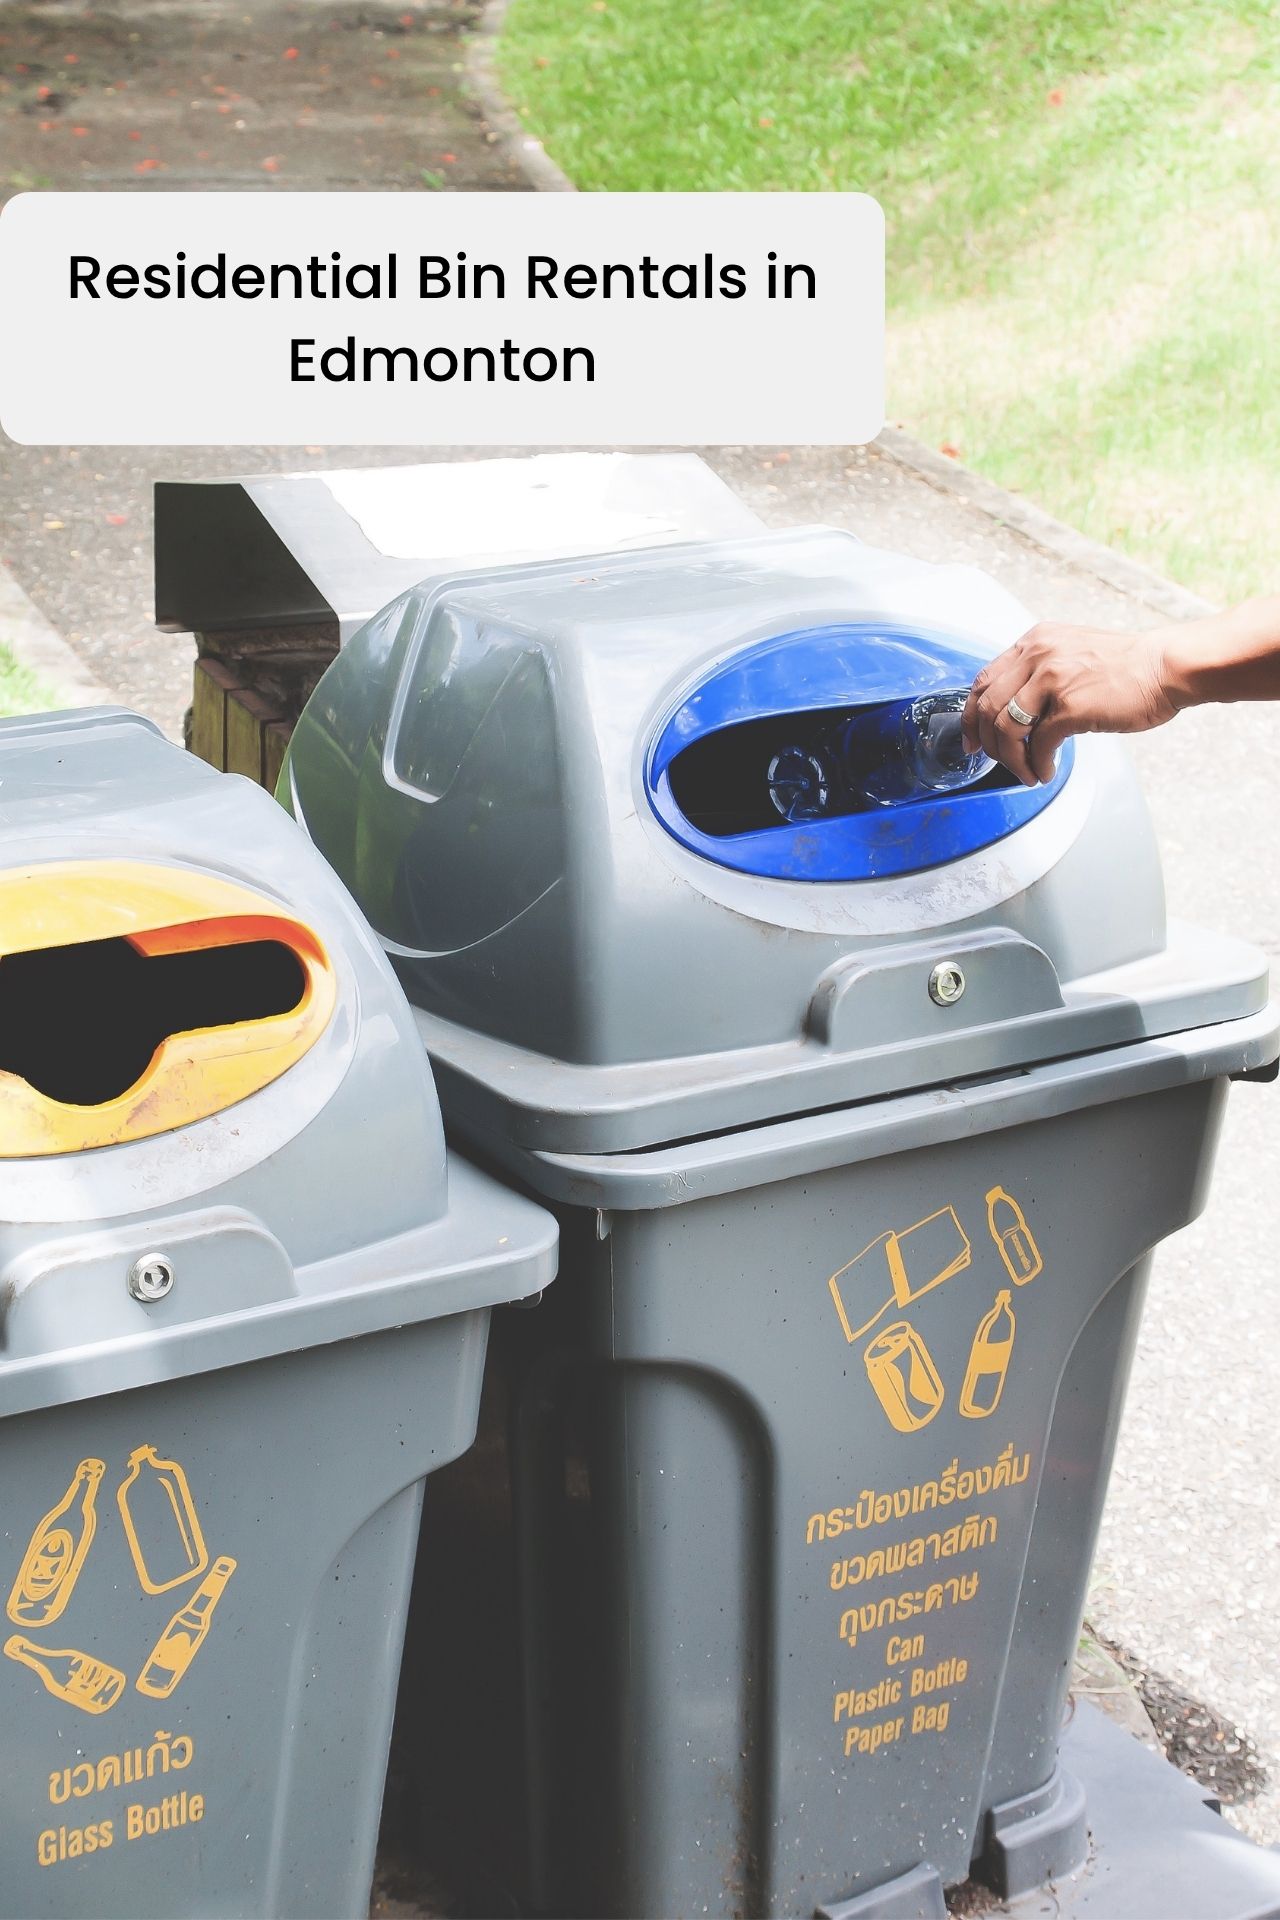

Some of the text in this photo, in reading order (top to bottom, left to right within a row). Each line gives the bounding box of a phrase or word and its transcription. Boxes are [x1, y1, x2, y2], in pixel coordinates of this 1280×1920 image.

[806, 1443, 1030, 1544] กระป๋องเครื่องดื่ม
[830, 1514, 998, 1590] ขวดพลาสติก
[838, 1571, 979, 1647] ถุงกระดาษ
[886, 1634, 925, 1666] Can
[833, 1657, 968, 1723] Plastic Bottle
[48, 1730, 193, 1804] ขวดแก้ว
[844, 1702, 950, 1757] Paper Bag
[37, 1791, 205, 1867] Glass Bottle
